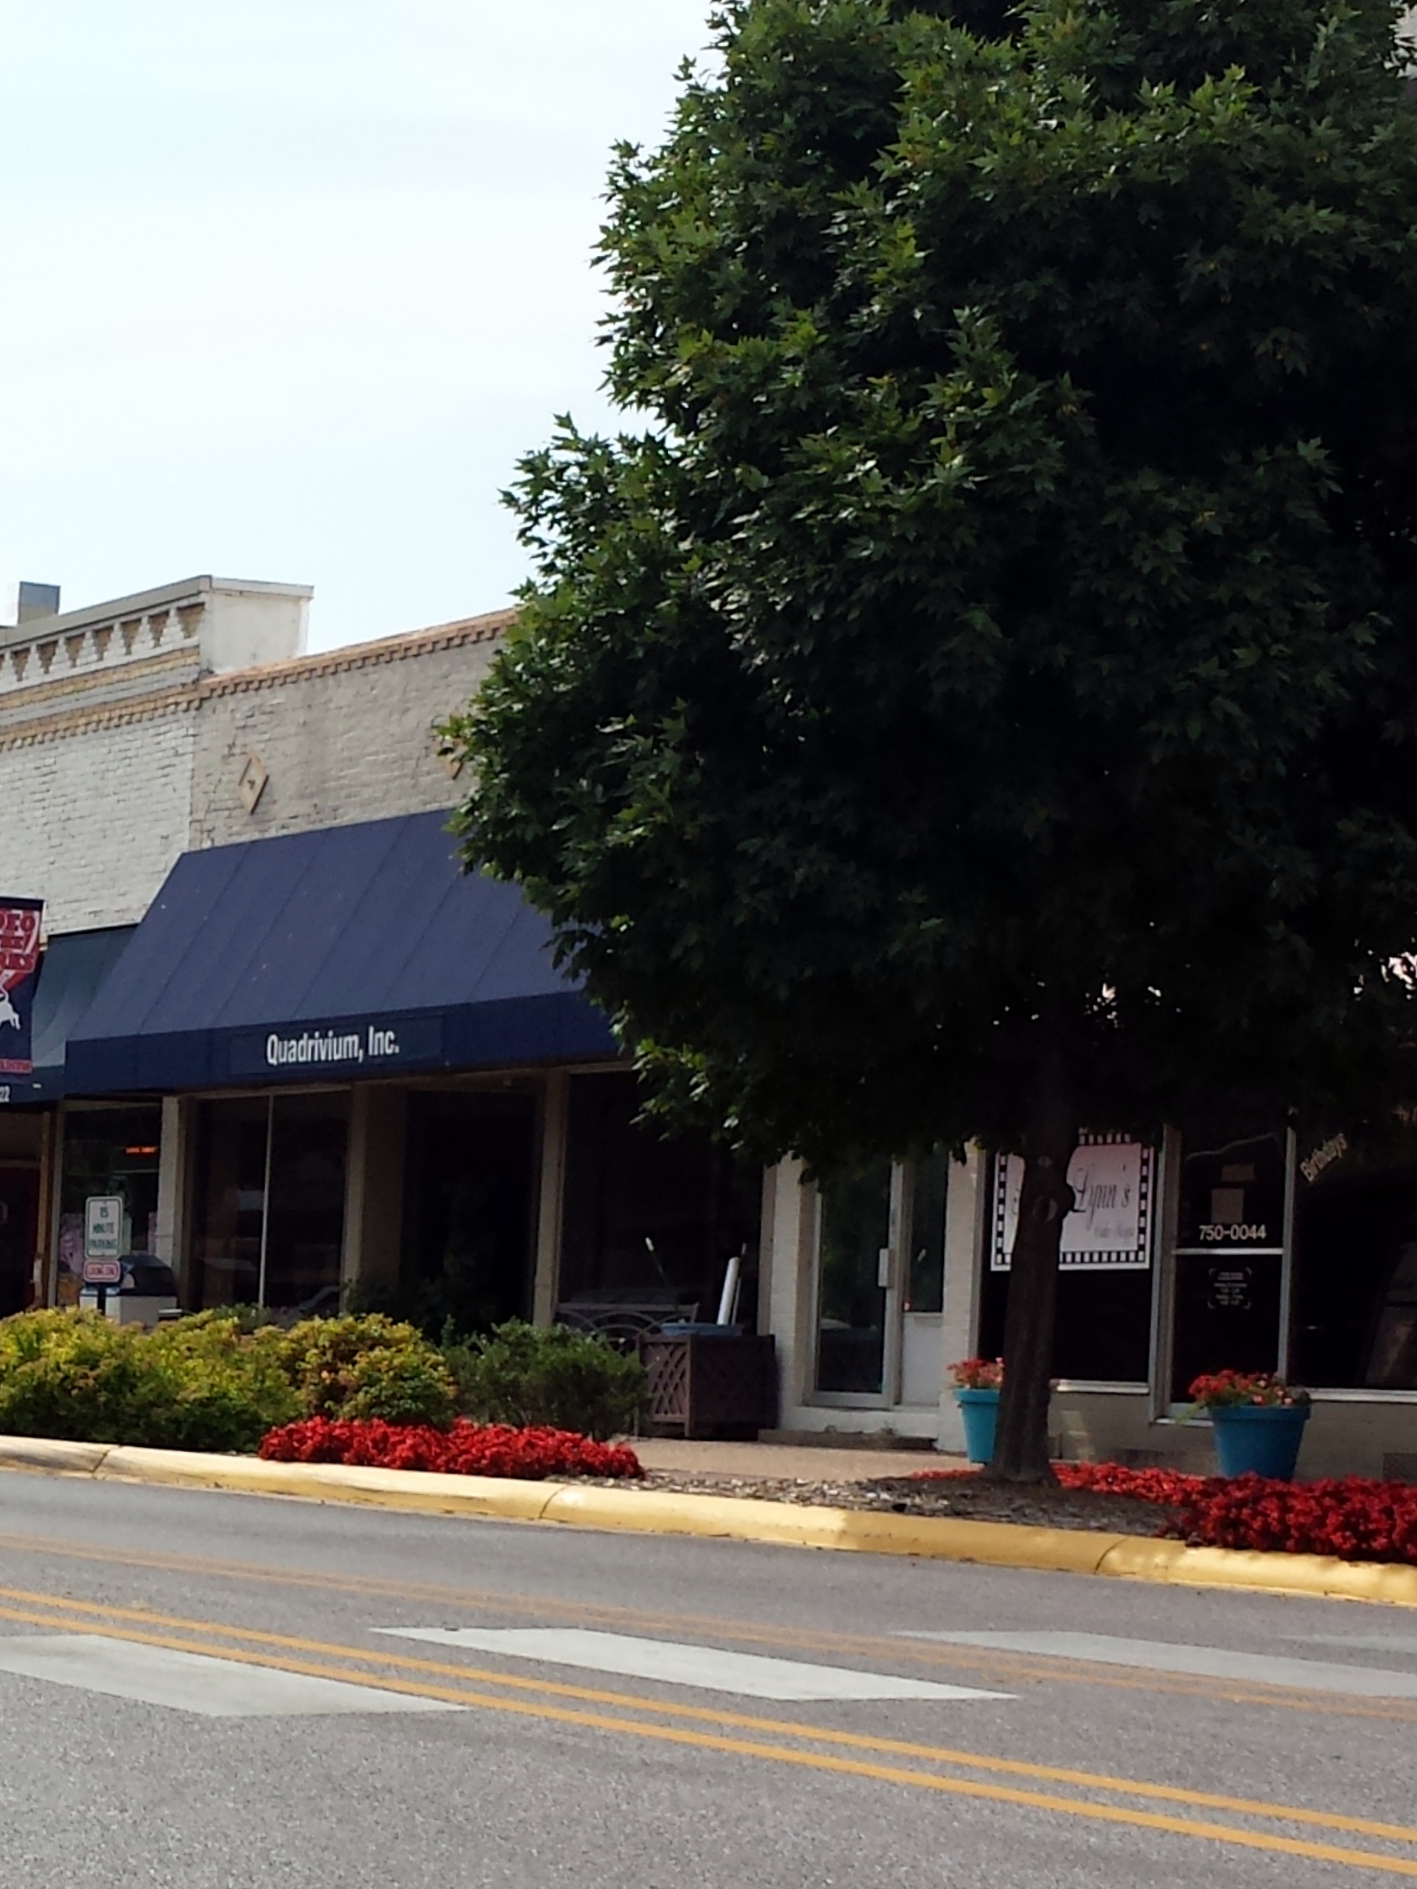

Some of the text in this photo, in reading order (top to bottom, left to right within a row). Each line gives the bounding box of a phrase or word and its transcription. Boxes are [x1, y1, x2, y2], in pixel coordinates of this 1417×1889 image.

[266, 1025, 400, 1066] Quadrivium, Inc.
[1198, 1223, 1267, 1242] 750-0044
